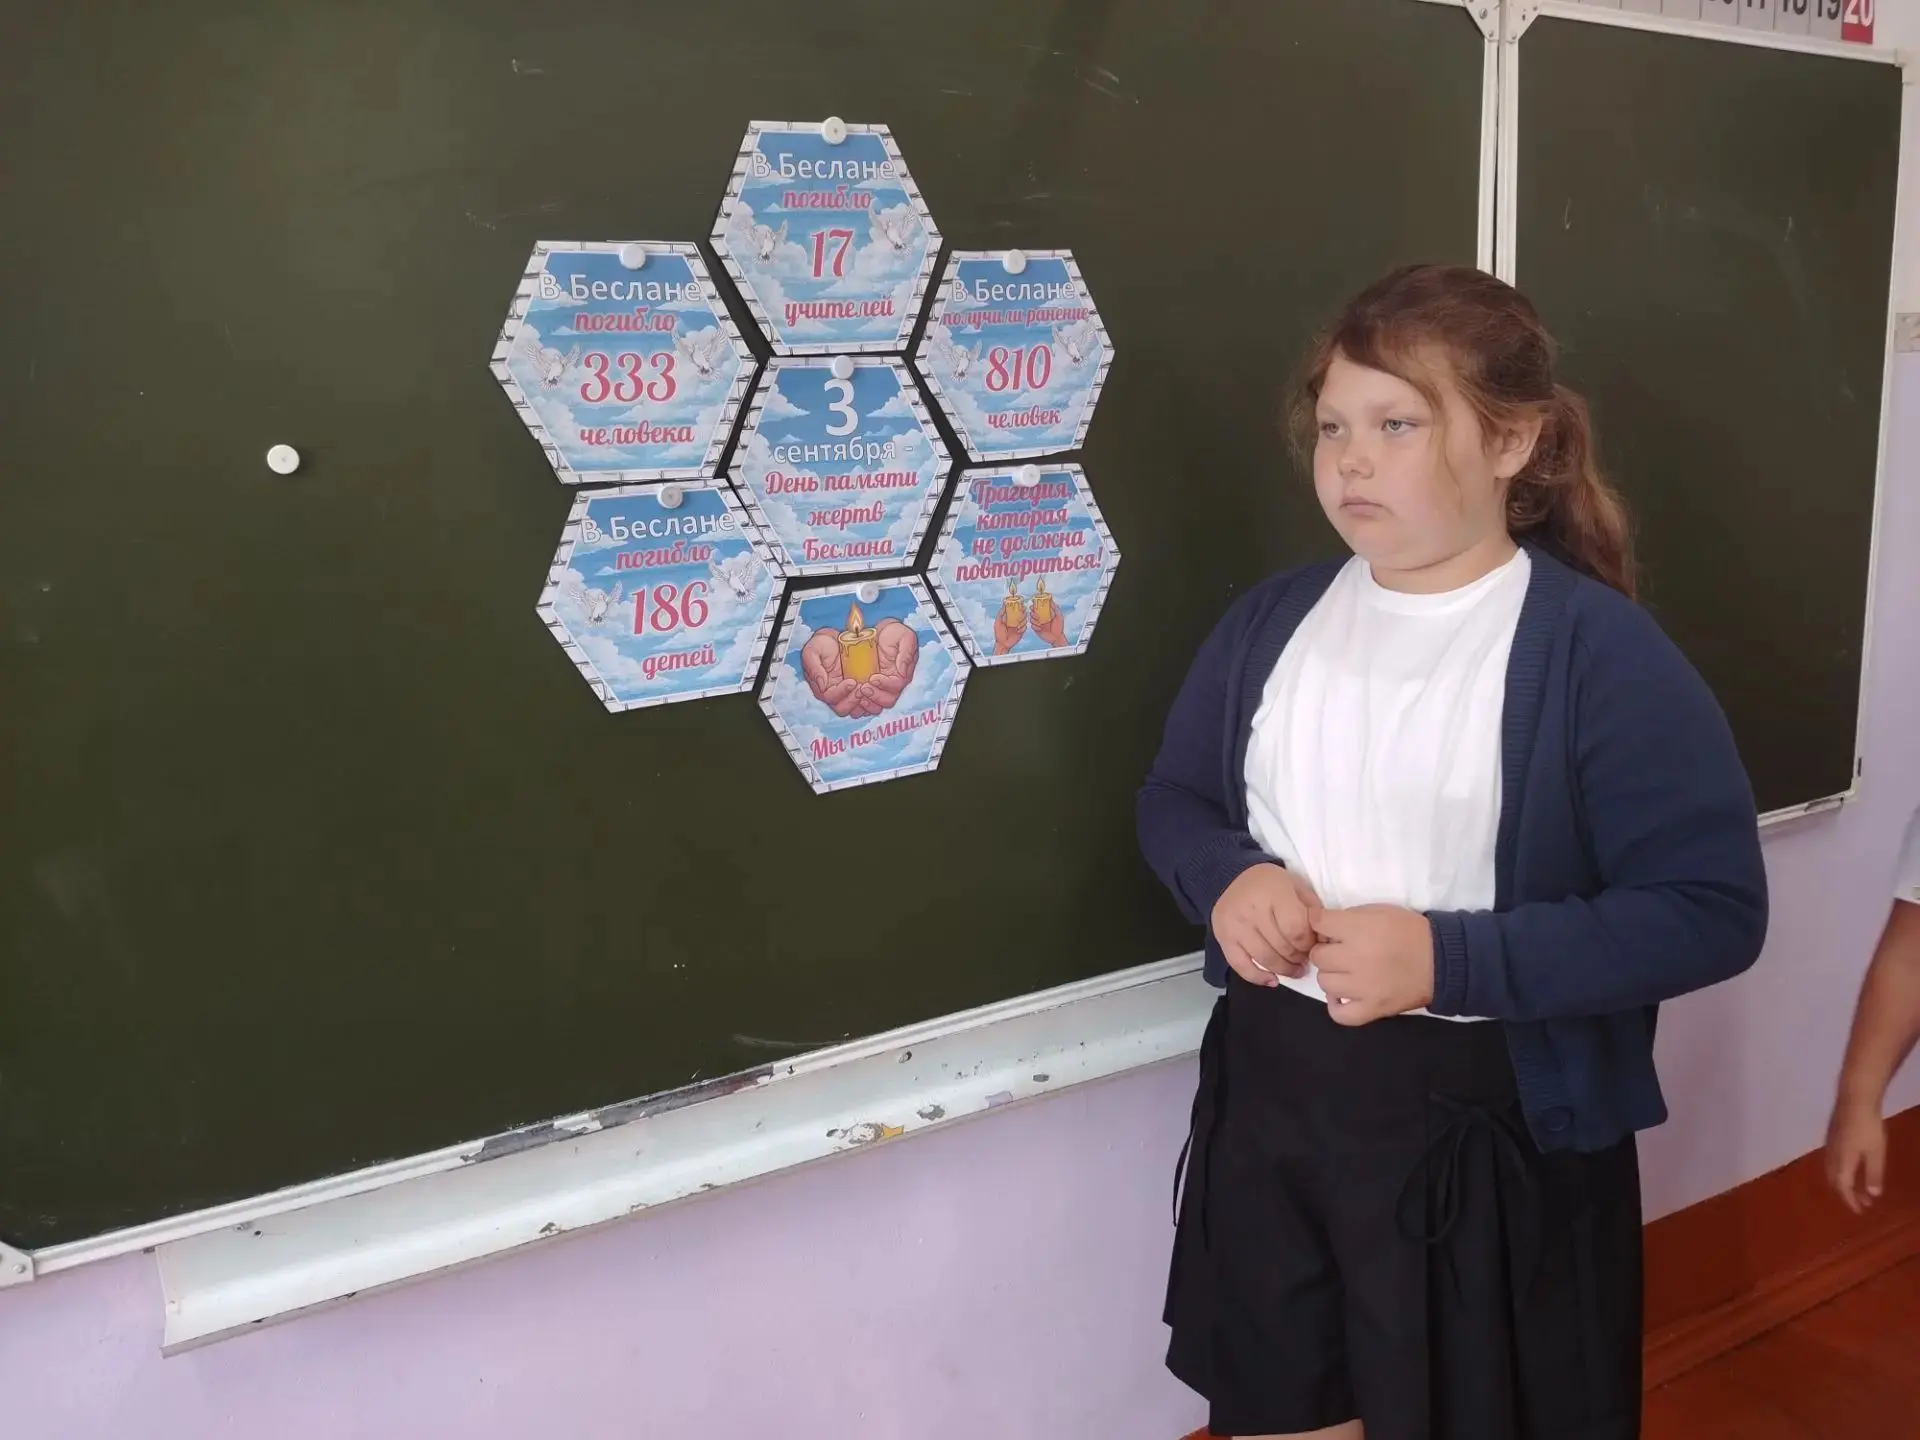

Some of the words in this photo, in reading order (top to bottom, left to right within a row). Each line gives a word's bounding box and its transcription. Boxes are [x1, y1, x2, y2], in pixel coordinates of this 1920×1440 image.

[1843, 0, 1873, 27] 20
[752, 153, 771, 178] В
[779, 153, 894, 179] Беслане
[783, 185, 873, 208] погибло
[811, 229, 853, 277] 17
[539, 274, 561, 300] В
[570, 274, 701, 301] Беслане
[952, 279, 968, 302] В
[975, 279, 1075, 301] Беслане
[575, 308, 676, 332] погибло
[785, 297, 895, 327] учителей
[943, 309, 1023, 329] получили
[1025, 306, 1089, 325] ранение
[580, 352, 677, 402] 333
[985, 344, 1051, 392] 810
[823, 379, 859, 436] 3
[988, 406, 1061, 429] человек
[579, 421, 694, 444] человека
[773, 436, 896, 464] сентября
[765, 472, 819, 495] День
[824, 470, 919, 491] памяти
[972, 480, 1073, 509] Трагедия,
[582, 519, 603, 544] В
[610, 512, 735, 541] Беслане
[807, 501, 884, 530] жертв
[976, 508, 1069, 533] которая
[616, 540, 712, 570] погибло
[803, 539, 893, 561] Беслана
[972, 536, 995, 555] не
[1000, 530, 1085, 559] должна
[955, 547, 1103, 581] повториться!
[632, 581, 709, 635] 186
[642, 645, 716, 680] детей
[810, 737, 846, 761] Мы
[850, 702, 942, 747] помним!
